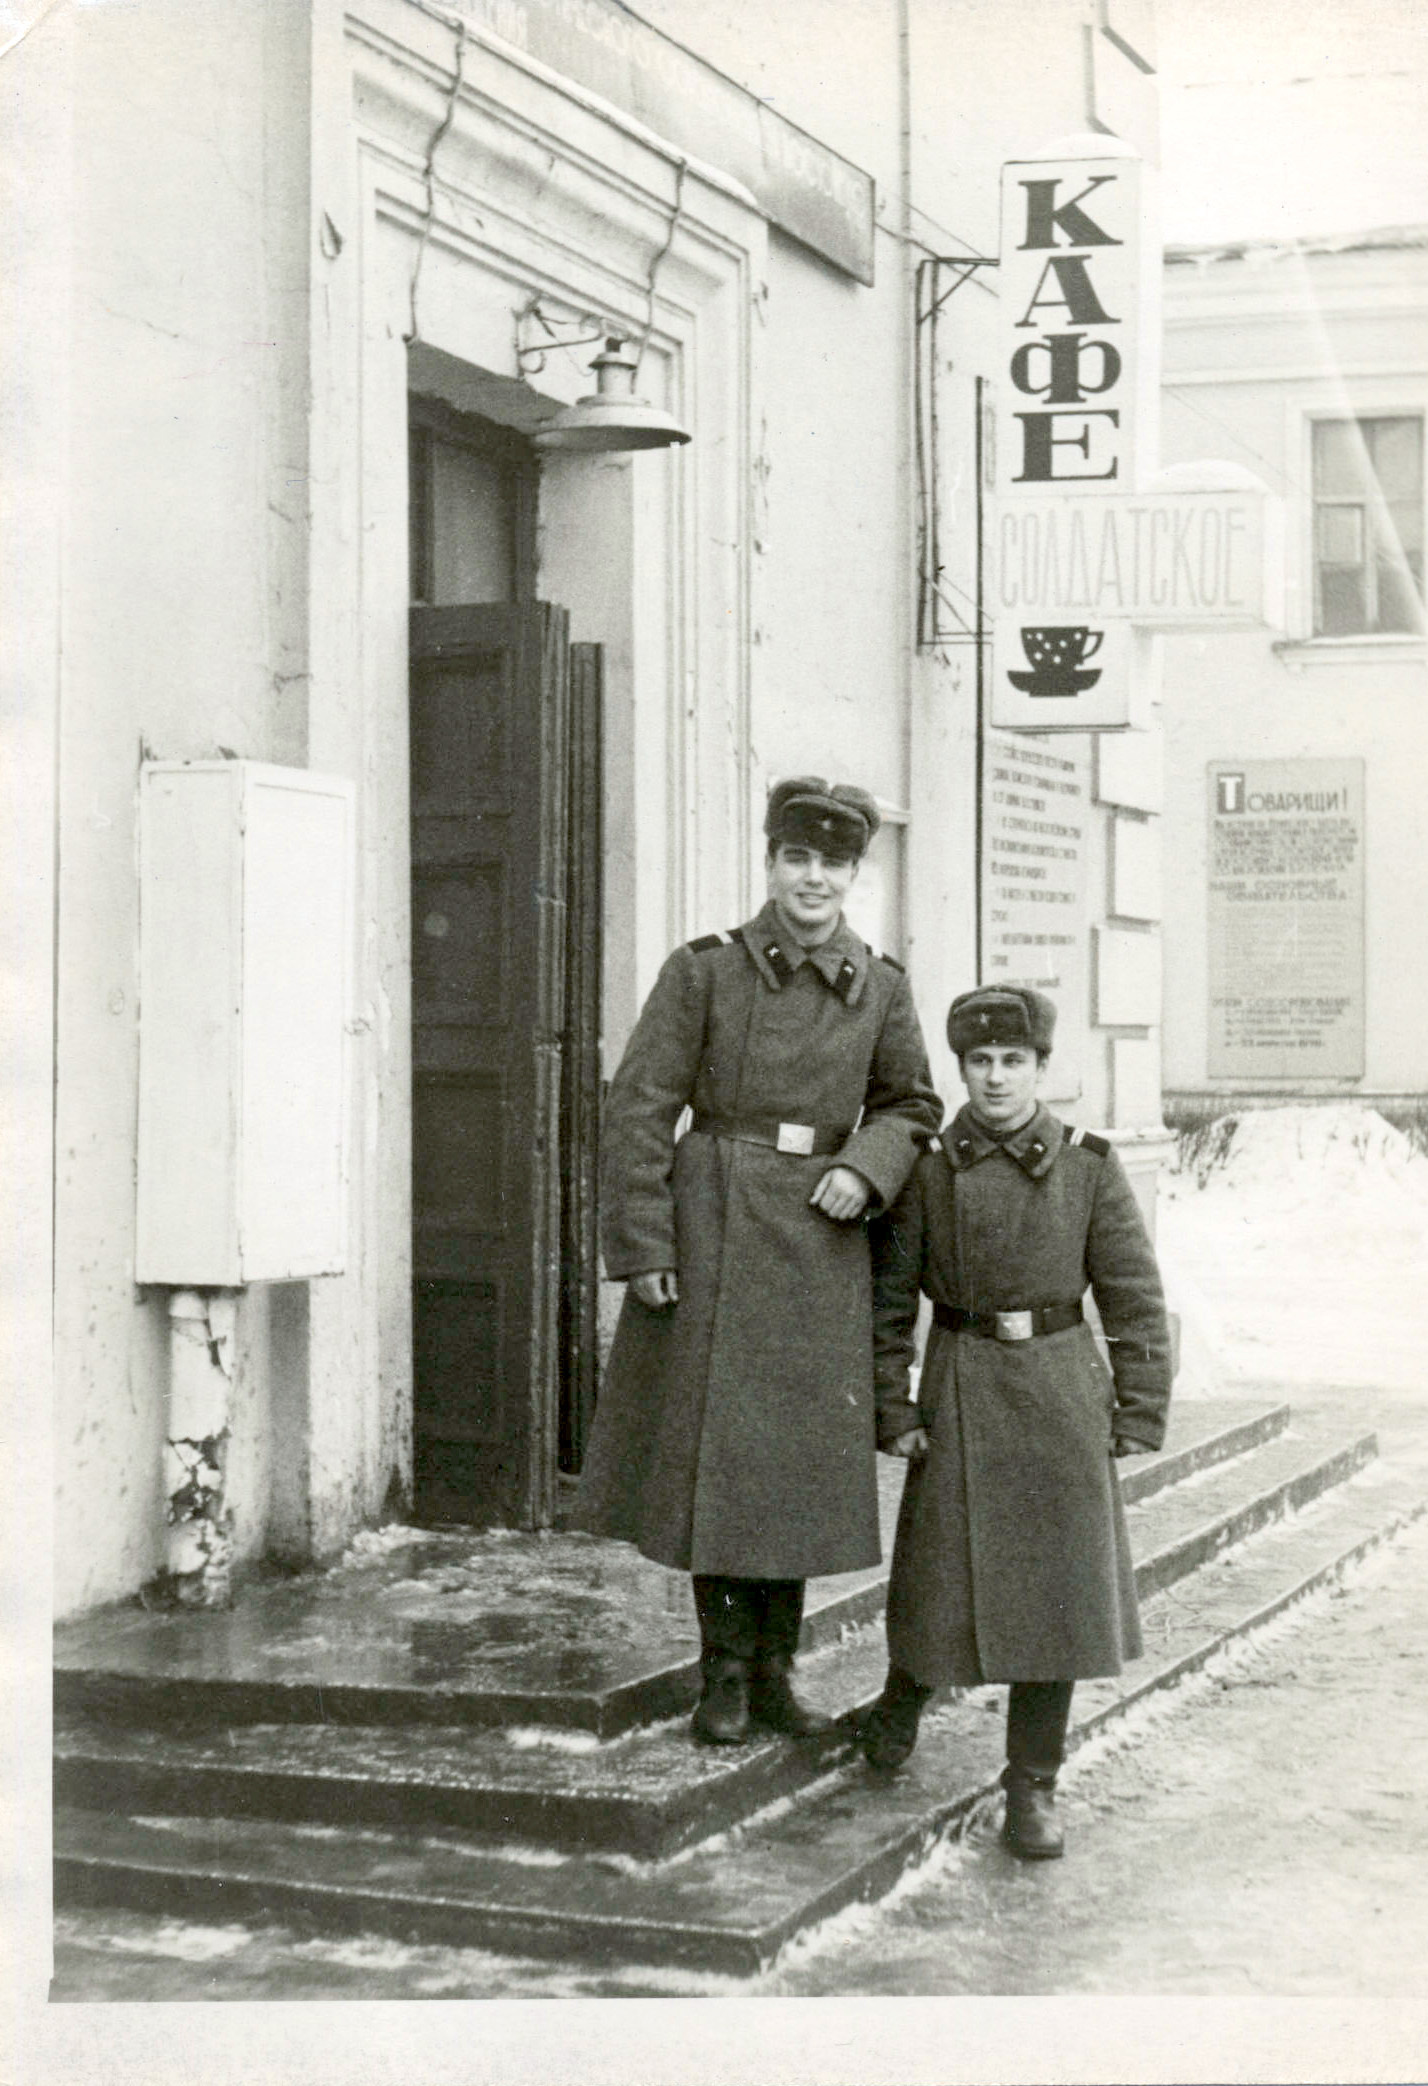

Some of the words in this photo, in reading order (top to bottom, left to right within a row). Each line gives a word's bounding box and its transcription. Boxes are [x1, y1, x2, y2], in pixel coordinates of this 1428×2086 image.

[1009, 175, 1124, 483] КАФЕ
[999, 506, 1246, 609] СОЛДАТСКОЕ
[1218, 774, 1348, 812] ТОВАРИЩИ!
